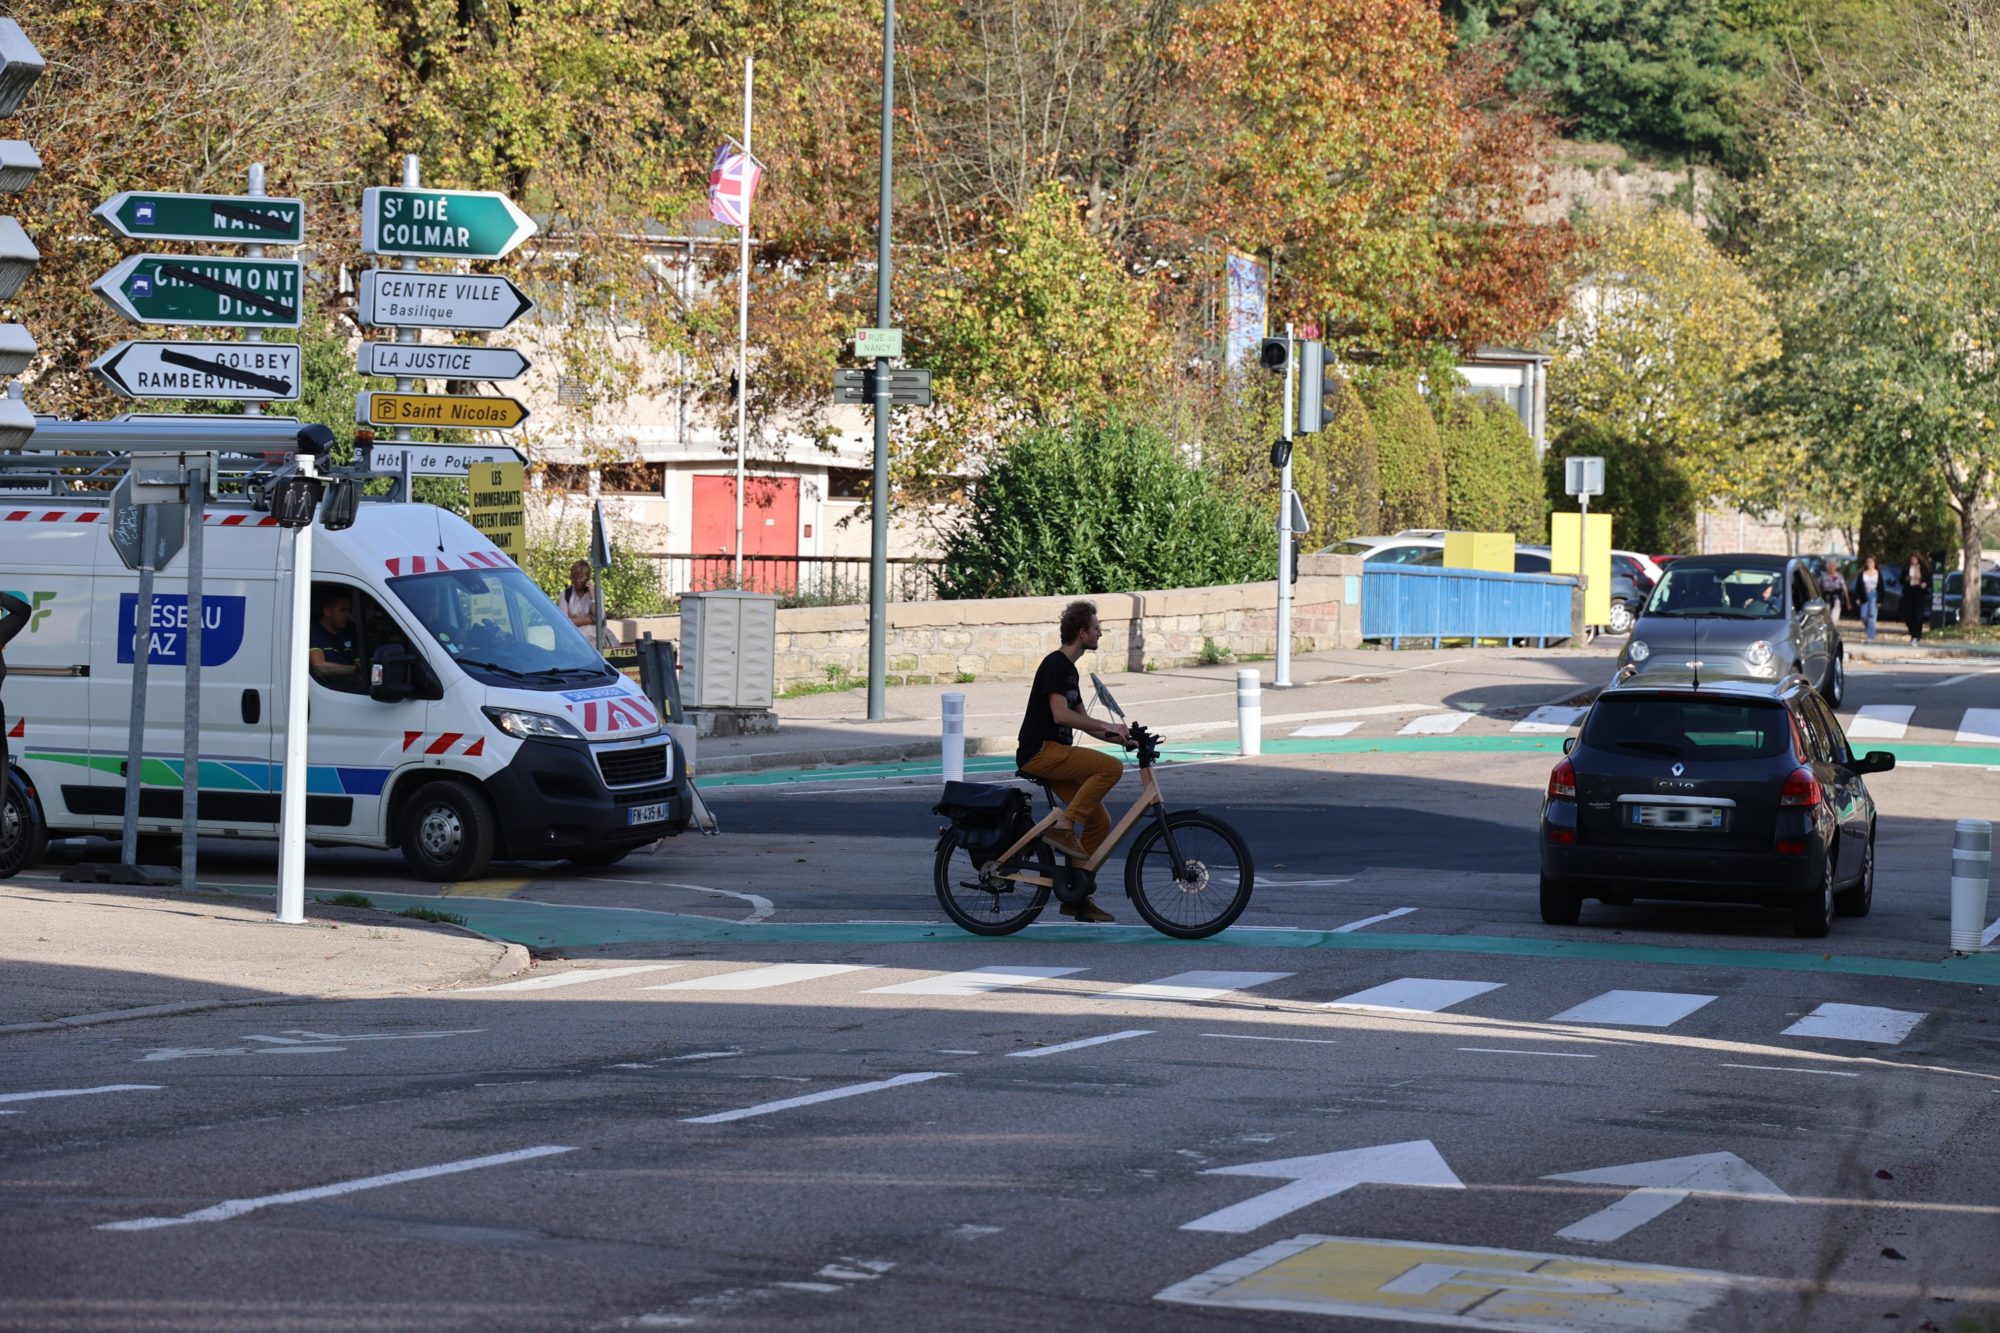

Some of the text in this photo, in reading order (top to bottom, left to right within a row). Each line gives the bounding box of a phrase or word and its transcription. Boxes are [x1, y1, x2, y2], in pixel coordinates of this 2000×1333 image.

[413, 196, 448, 220] DIÉ
[383, 223, 470, 247] COLMAR
[381, 281, 501, 301] CENTRE VILLE
[868, 333, 885, 342] RUE
[864, 344, 891, 352] NANCY
[216, 353, 291, 369] GOLBEY
[379, 352, 472, 370] LA JUSTICE
[138, 371, 290, 390] RAMBERVILS
[401, 402, 443, 418] Saint
[451, 404, 507, 421] Nicolas
[376, 453, 489, 468] Hôtl de Poli
[491, 471, 502, 486] LES
[474, 491, 520, 509] COMMERÇANTS
[472, 511, 523, 528] RESTENT OUVERT
[484, 533, 512, 548] ENDANT
[133, 598, 221, 628] ÉSEU
[132, 631, 176, 655] AZ
